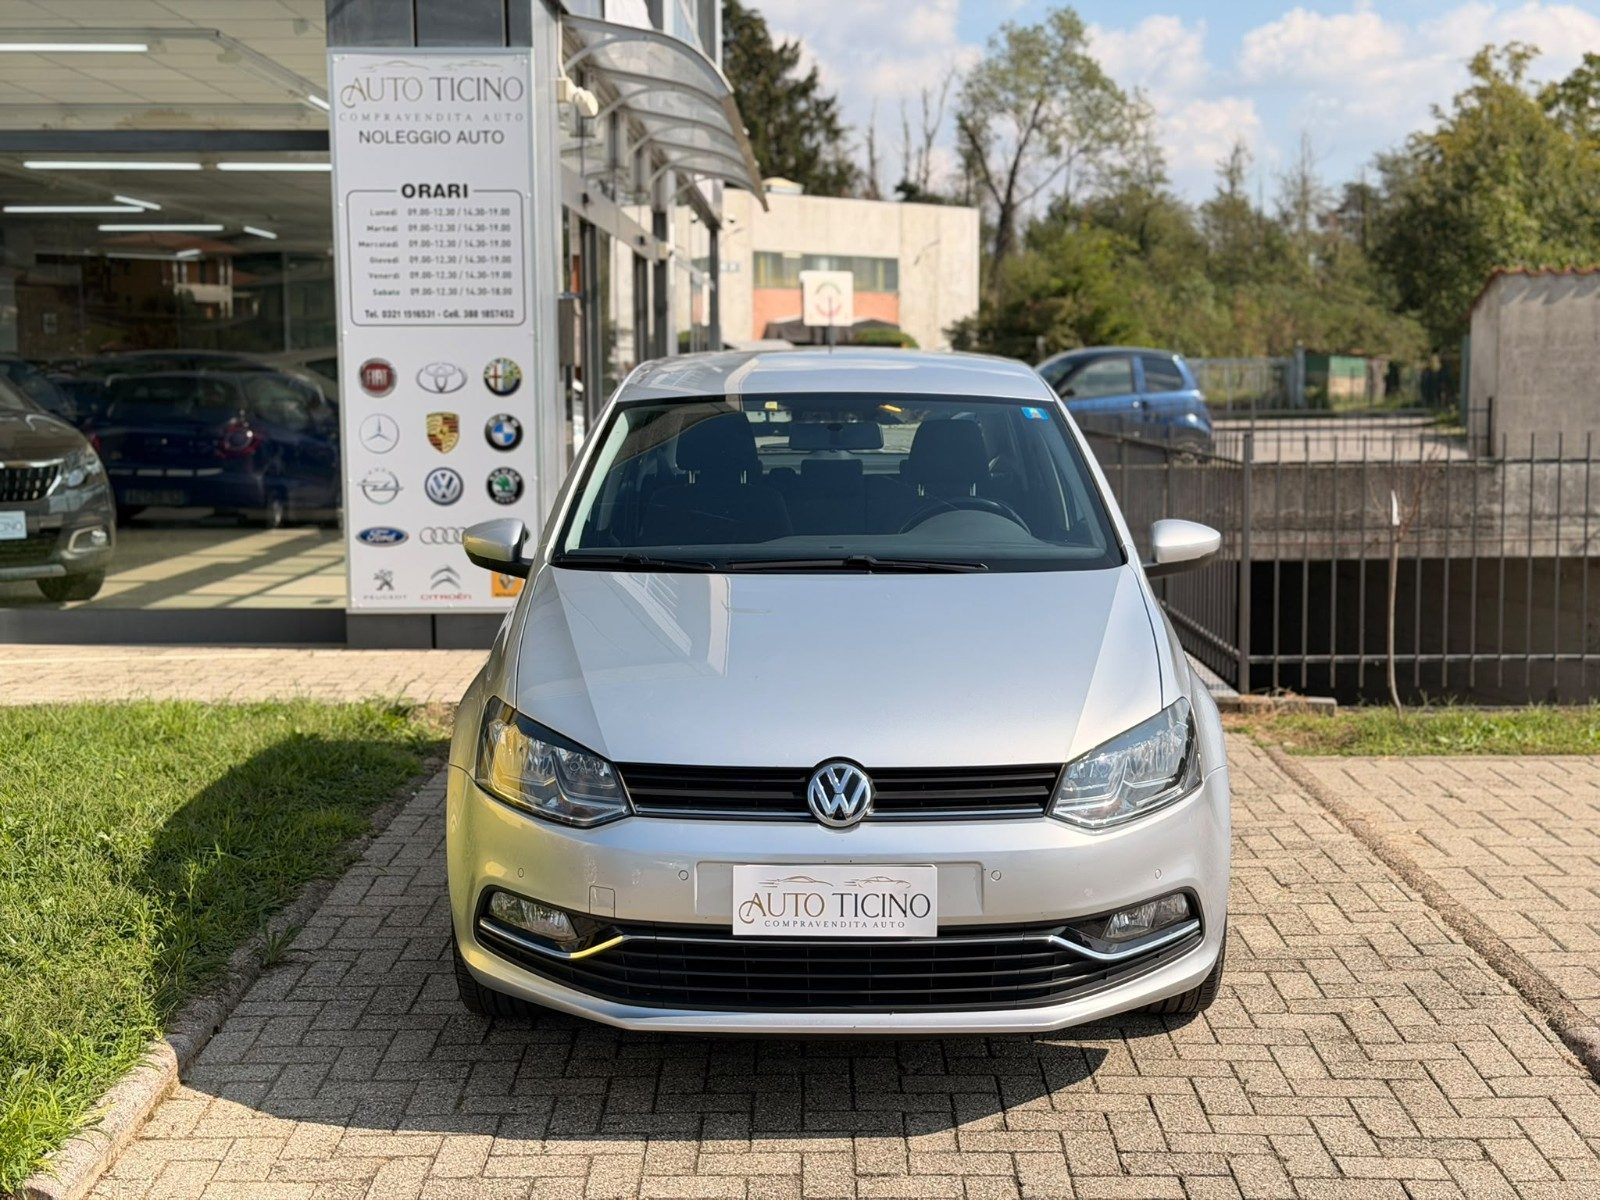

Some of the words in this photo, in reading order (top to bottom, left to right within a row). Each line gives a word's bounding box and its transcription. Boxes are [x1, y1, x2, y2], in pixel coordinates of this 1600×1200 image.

[340, 76, 423, 108] AUTO
[429, 76, 524, 102] TICINO
[339, 112, 473, 122] COMPRAVENDITA
[482, 112, 524, 122] AUTO
[358, 129, 451, 145] NOLEGGIO
[456, 129, 505, 145] AUTO
[401, 183, 469, 199] ORARI
[364, 309, 379, 319] Tel.
[366, 369, 388, 385] FIAT
[738, 892, 825, 924] AUTO
[831, 892, 931, 919] TICINO
[764, 920, 868, 928] COMPRAVENDITA
[872, 921, 905, 929] AUTO
